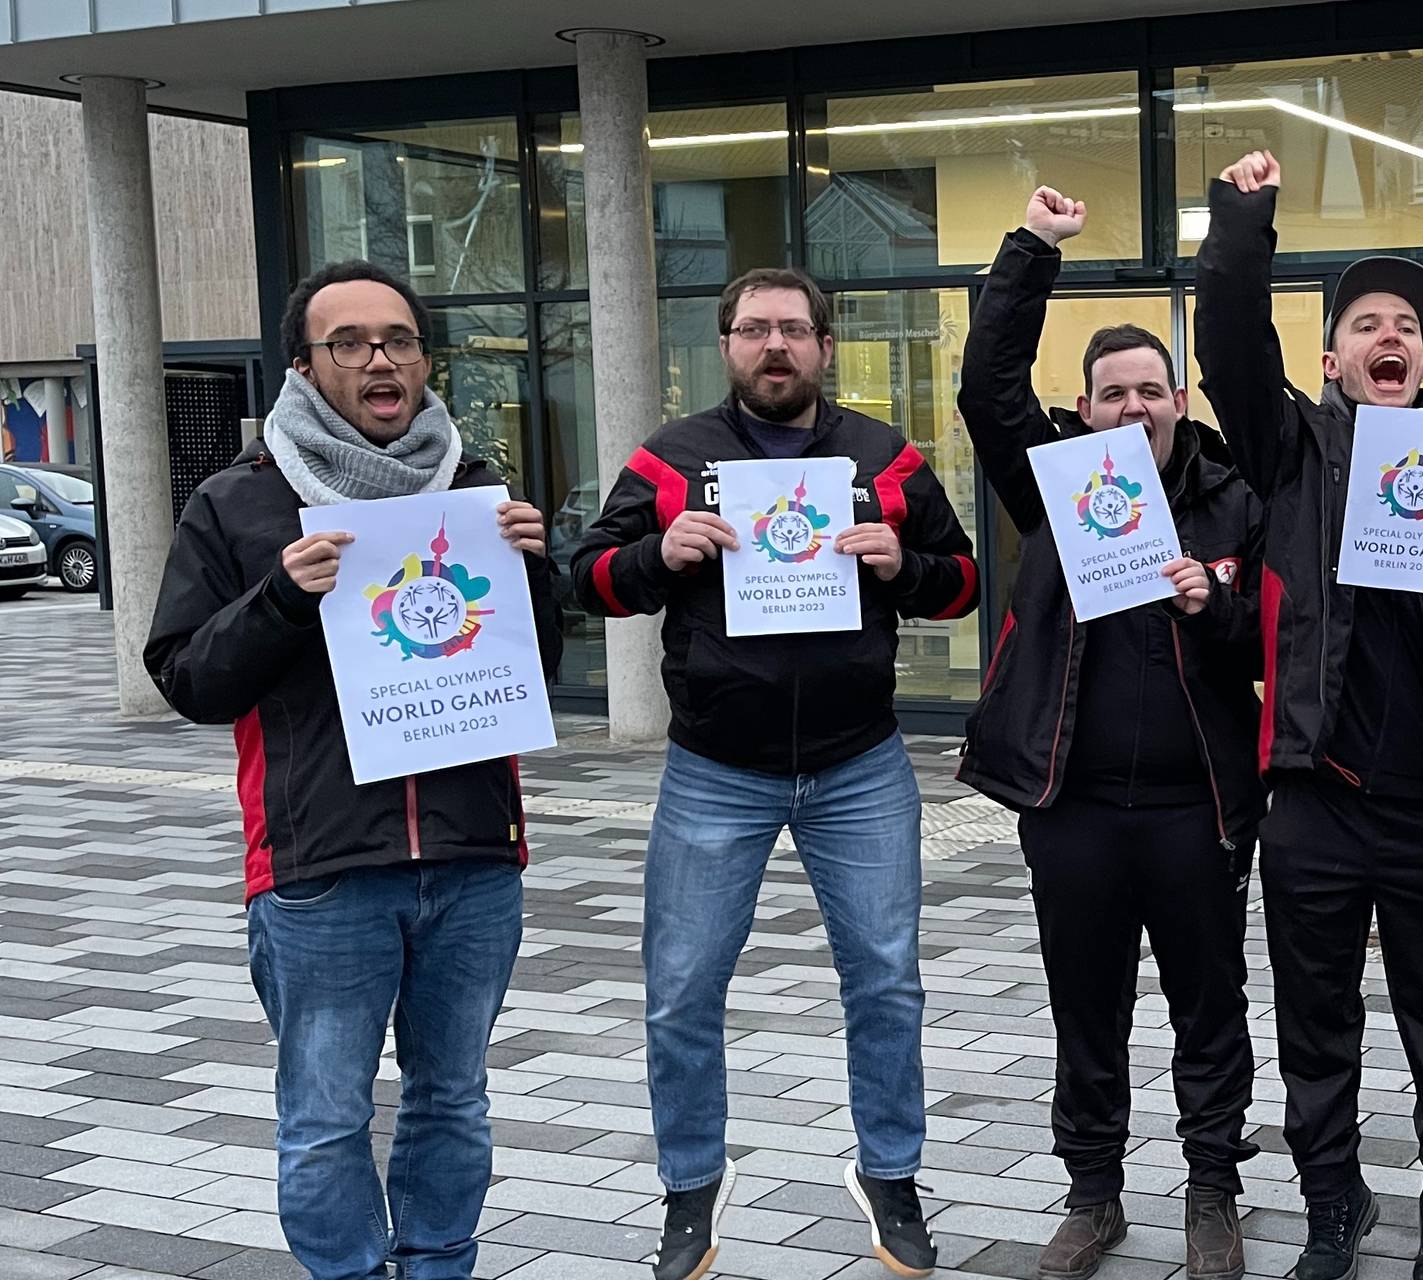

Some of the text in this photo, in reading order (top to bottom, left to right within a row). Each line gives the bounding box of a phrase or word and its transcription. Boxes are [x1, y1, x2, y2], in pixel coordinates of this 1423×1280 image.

[1364, 528, 1400, 538] SPECIAL
[1081, 538, 1164, 567] SPECIAL OLYMPICS
[1354, 540, 1405, 555] WORLD
[1078, 550, 1174, 584] WORLD GAMES
[1375, 560, 1406, 569] BERLIN
[745, 573, 838, 584] SPECIAL OLYMPICS
[1103, 572, 1159, 593] BERLIN 2023
[738, 586, 846, 600] WORLD GAMES
[762, 603, 824, 613] BERLIN 2023
[371, 666, 511, 699] SPECIAL OLYMPICS
[362, 684, 527, 726] WORLD GAMES
[404, 715, 498, 742] BERLIN 2023
